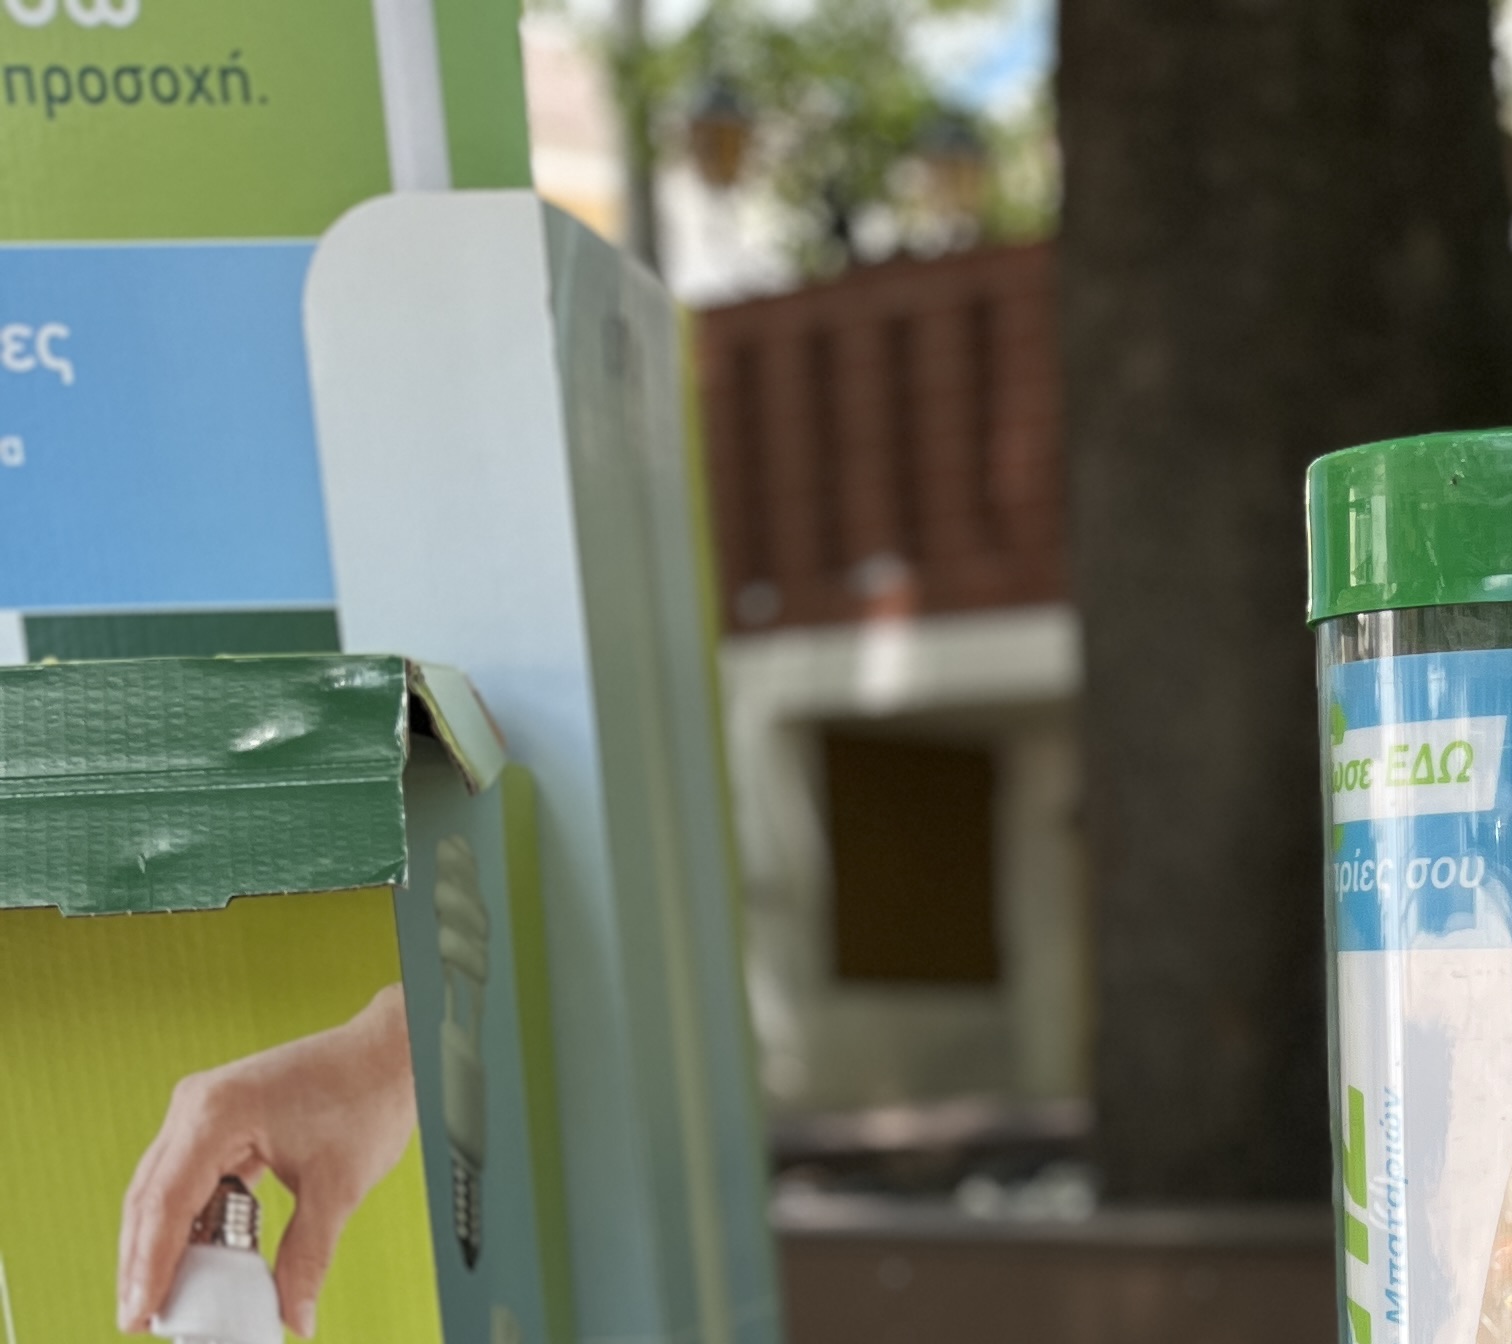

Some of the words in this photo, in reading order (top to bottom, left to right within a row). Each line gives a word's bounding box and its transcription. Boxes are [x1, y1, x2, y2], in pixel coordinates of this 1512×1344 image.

[3, 49, 269, 121] προσοχή.
[1385, 740, 1475, 787] ΕΔΩ
[1406, 856, 1485, 889] σου
[1383, 1086, 1410, 1325] Μπαταριών
